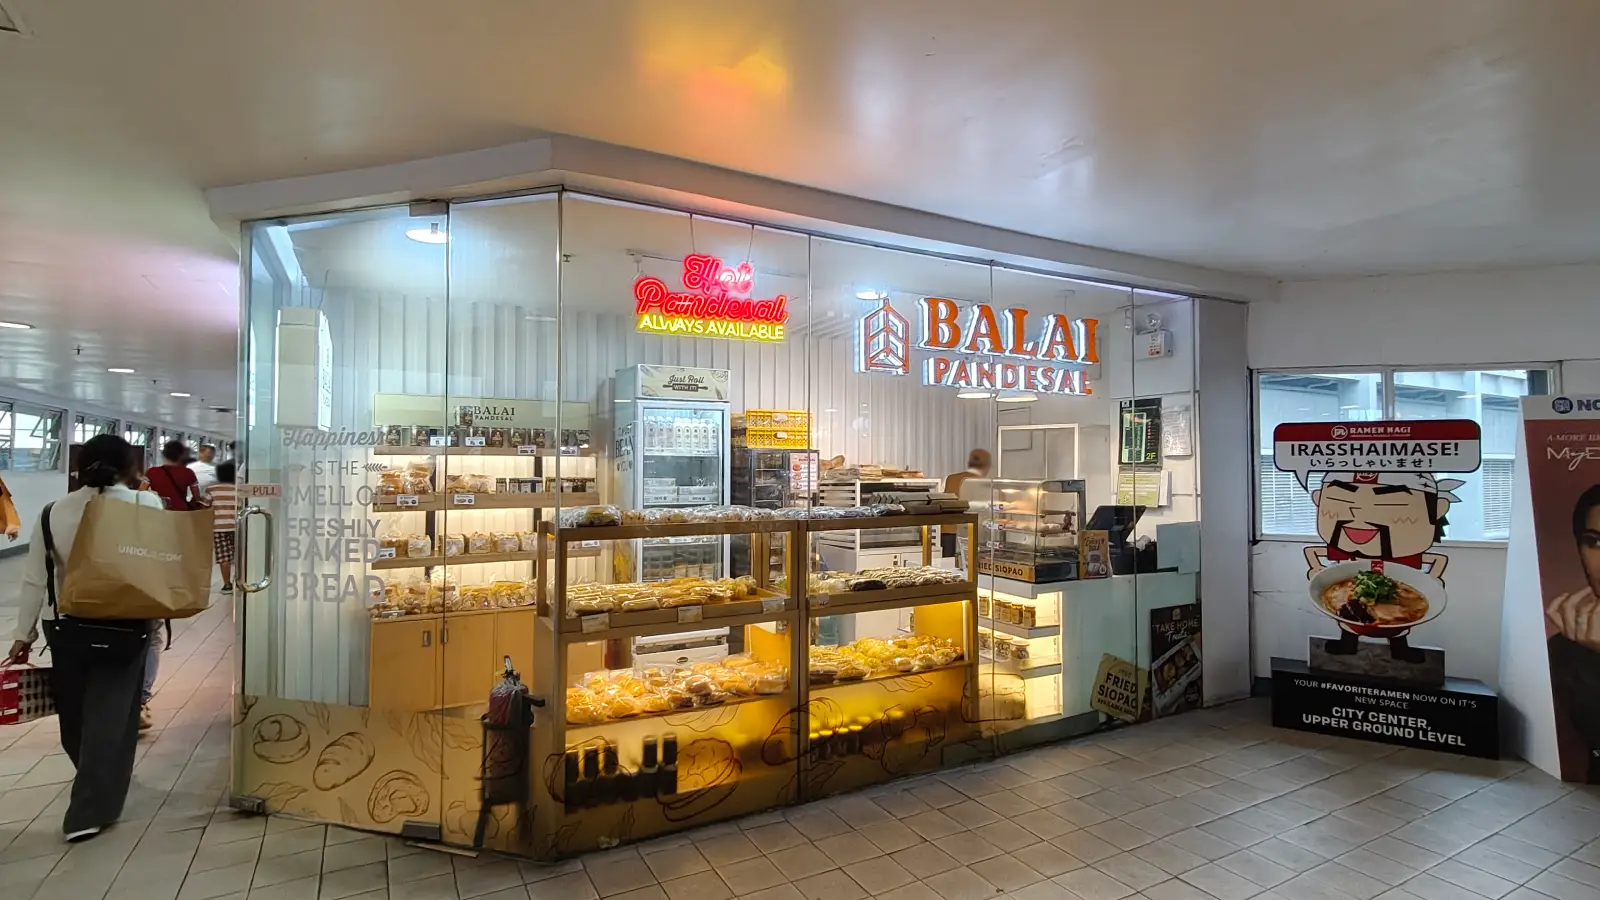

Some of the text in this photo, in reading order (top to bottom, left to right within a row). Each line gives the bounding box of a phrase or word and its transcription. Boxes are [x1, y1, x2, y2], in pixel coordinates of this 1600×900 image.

[684, 254, 754, 294] Hot
[635, 276, 789, 324] Pandesal
[639, 313, 785, 341] ALWAYS AVAILABLE
[917, 296, 1100, 364] BALAI
[923, 356, 1094, 396] PANDESAL
[474, 406, 516, 416] BALAI
[283, 427, 385, 451] Happiness
[1350, 426, 1411, 434] RAMEN NAGI
[1290, 442, 1459, 456] IRASSHAIMASE!
[327, 461, 359, 475] THE
[1310, 458, 1433, 468] いらっしゃいませ！
[252, 486, 276, 497] PULL
[286, 518, 381, 538] FRESHLY
[286, 538, 381, 563] BAKED
[994, 564, 1024, 576] SIOPAO
[286, 573, 385, 603] BREAD
[1105, 672, 1137, 694] FRIED
[1294, 679, 1477, 708] YOUR #FAVORITERAMEN NOW ON IT'S
[1097, 684, 1138, 709] SIOPAO
[1354, 695, 1409, 710] NEW SPACE
[1302, 713, 1466, 746] UPPER GROUND LEVEL
[1332, 706, 1432, 730] CITY CENTER,
